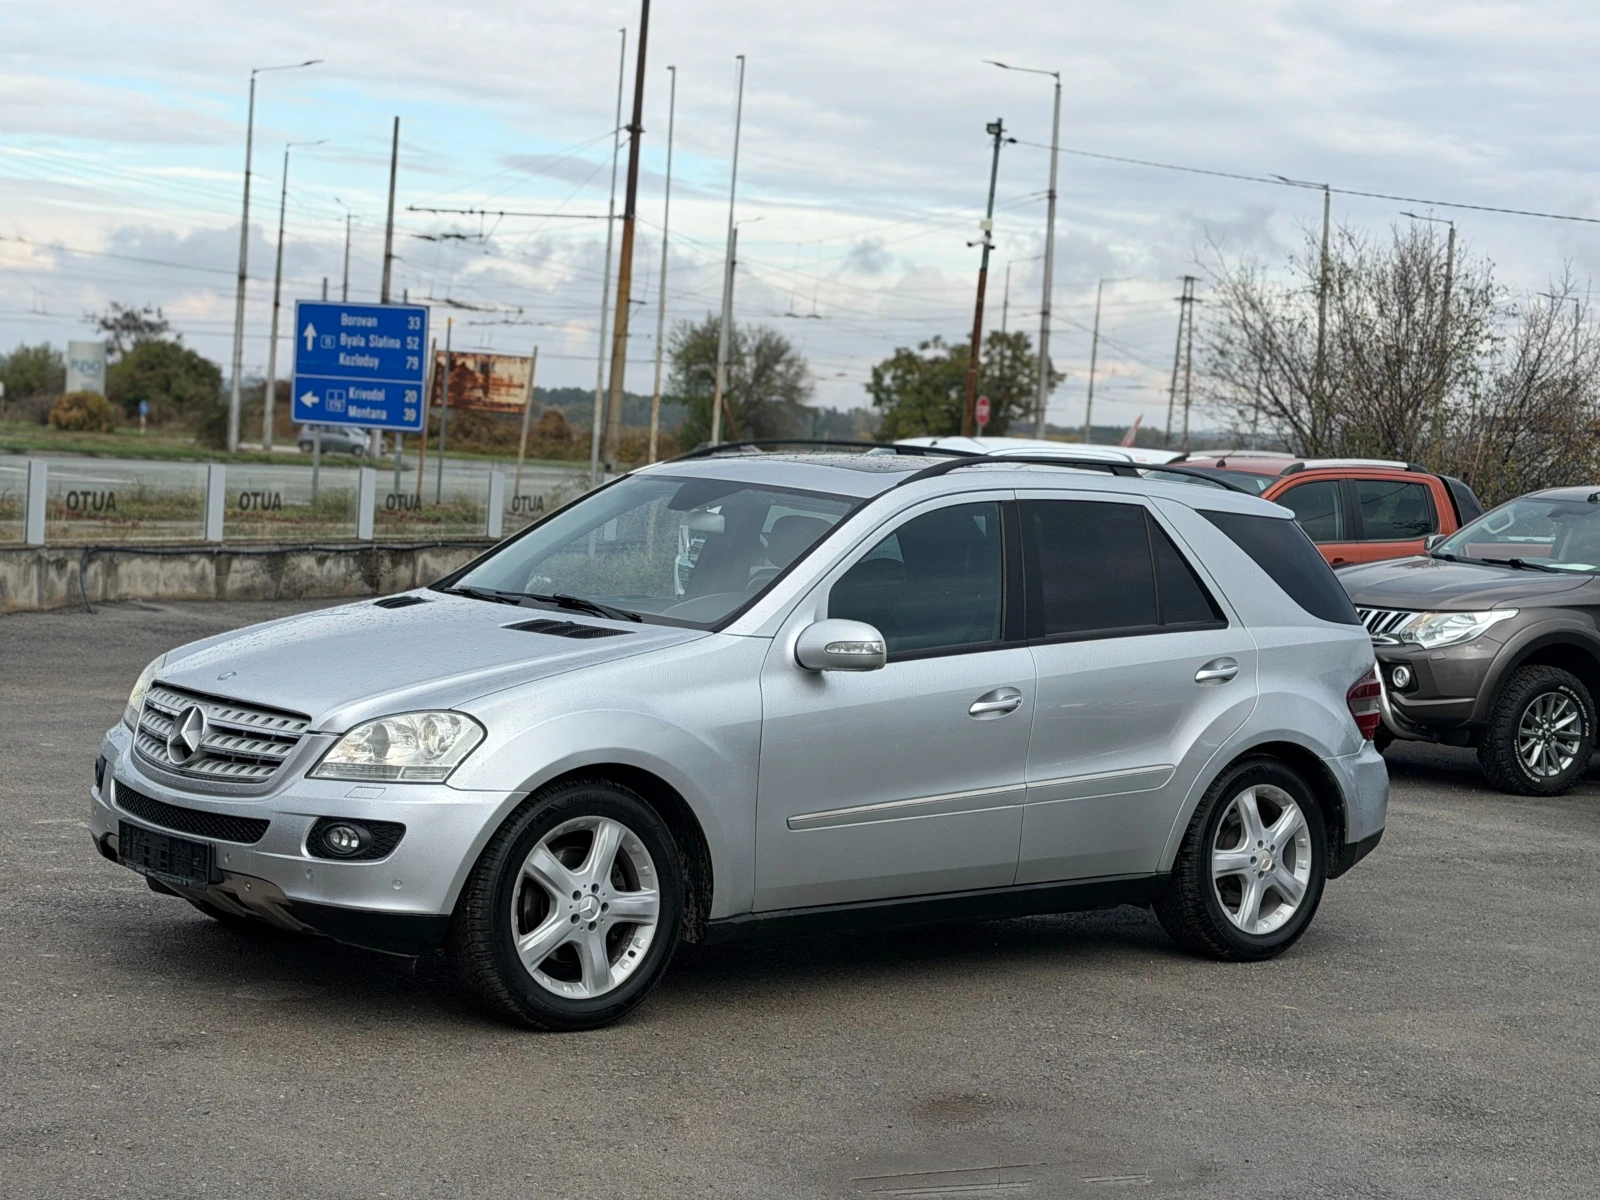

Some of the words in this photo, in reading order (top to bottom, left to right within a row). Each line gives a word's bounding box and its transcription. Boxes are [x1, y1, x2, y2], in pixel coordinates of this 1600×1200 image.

[341, 313, 378, 327] Borovan
[407, 316, 421, 330] 33
[340, 332, 366, 349] Byala
[369, 334, 401, 349] Slatina
[406, 336, 420, 350] 52
[339, 353, 380, 370] Kozloduy
[406, 356, 419, 370] 79
[349, 386, 385, 401] Krivodol
[404, 389, 418, 403] 20
[348, 405, 387, 420] Montana
[403, 408, 417, 422] 39
